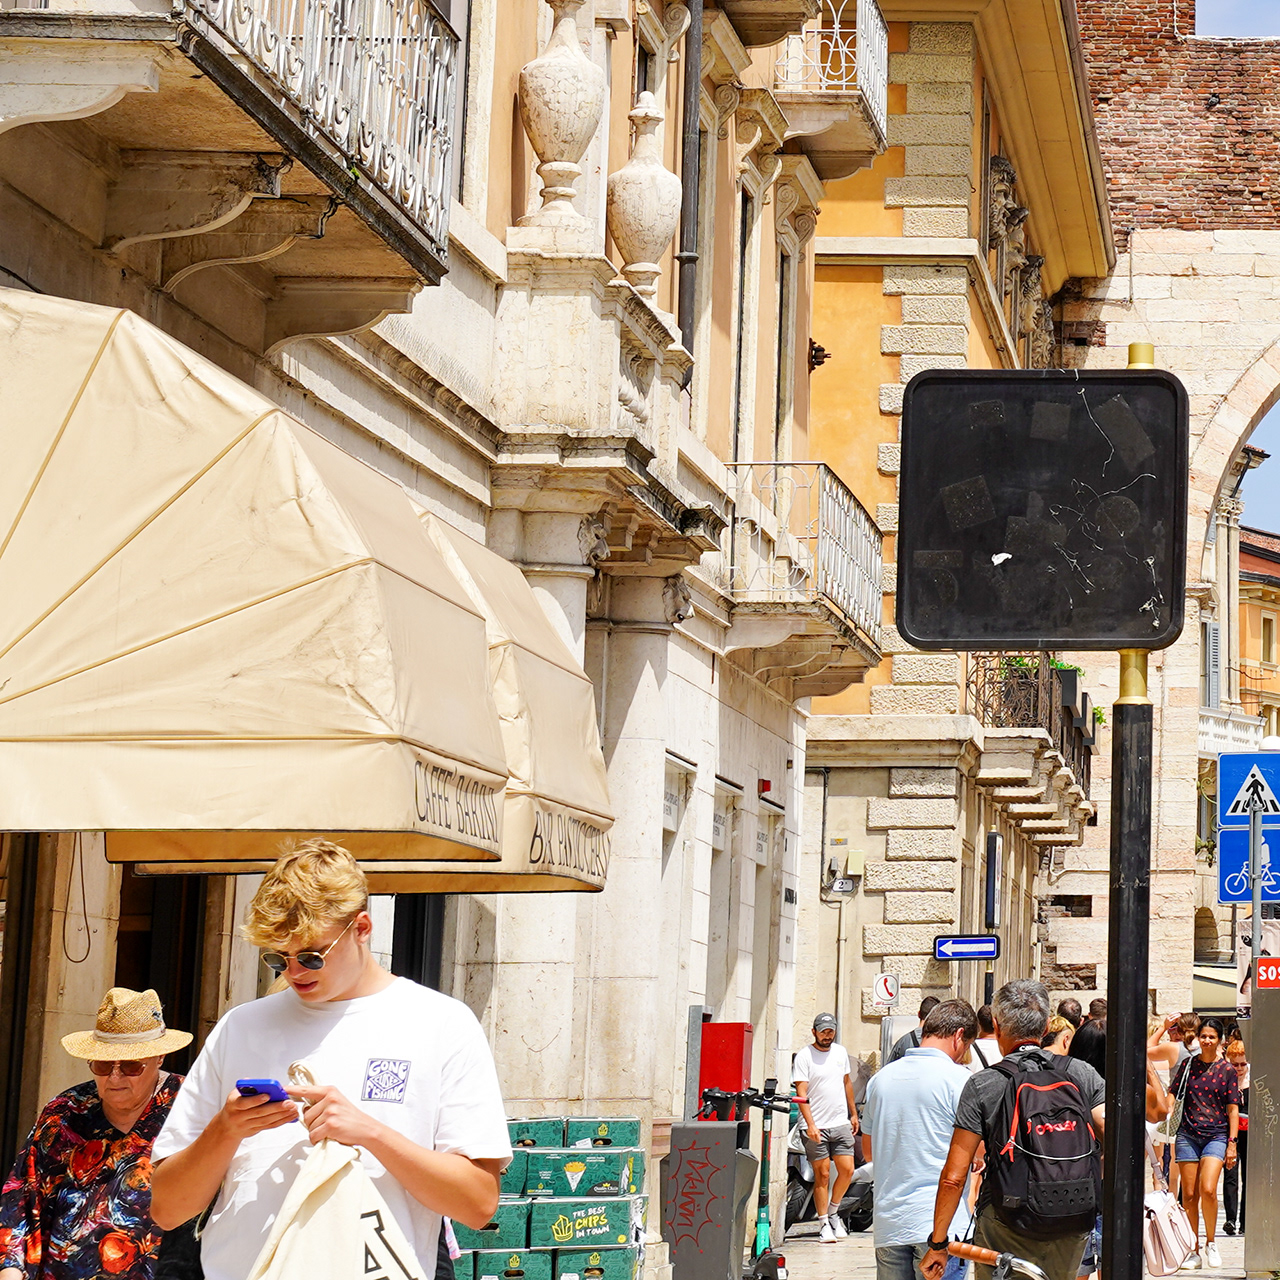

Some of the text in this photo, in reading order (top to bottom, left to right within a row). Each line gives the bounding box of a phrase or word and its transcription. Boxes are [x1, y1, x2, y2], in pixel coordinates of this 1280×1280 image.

[573, 1206, 606, 1219] THE BEST
[575, 1213, 608, 1230] CHIPS
[576, 1225, 610, 1238] IN TOWN
